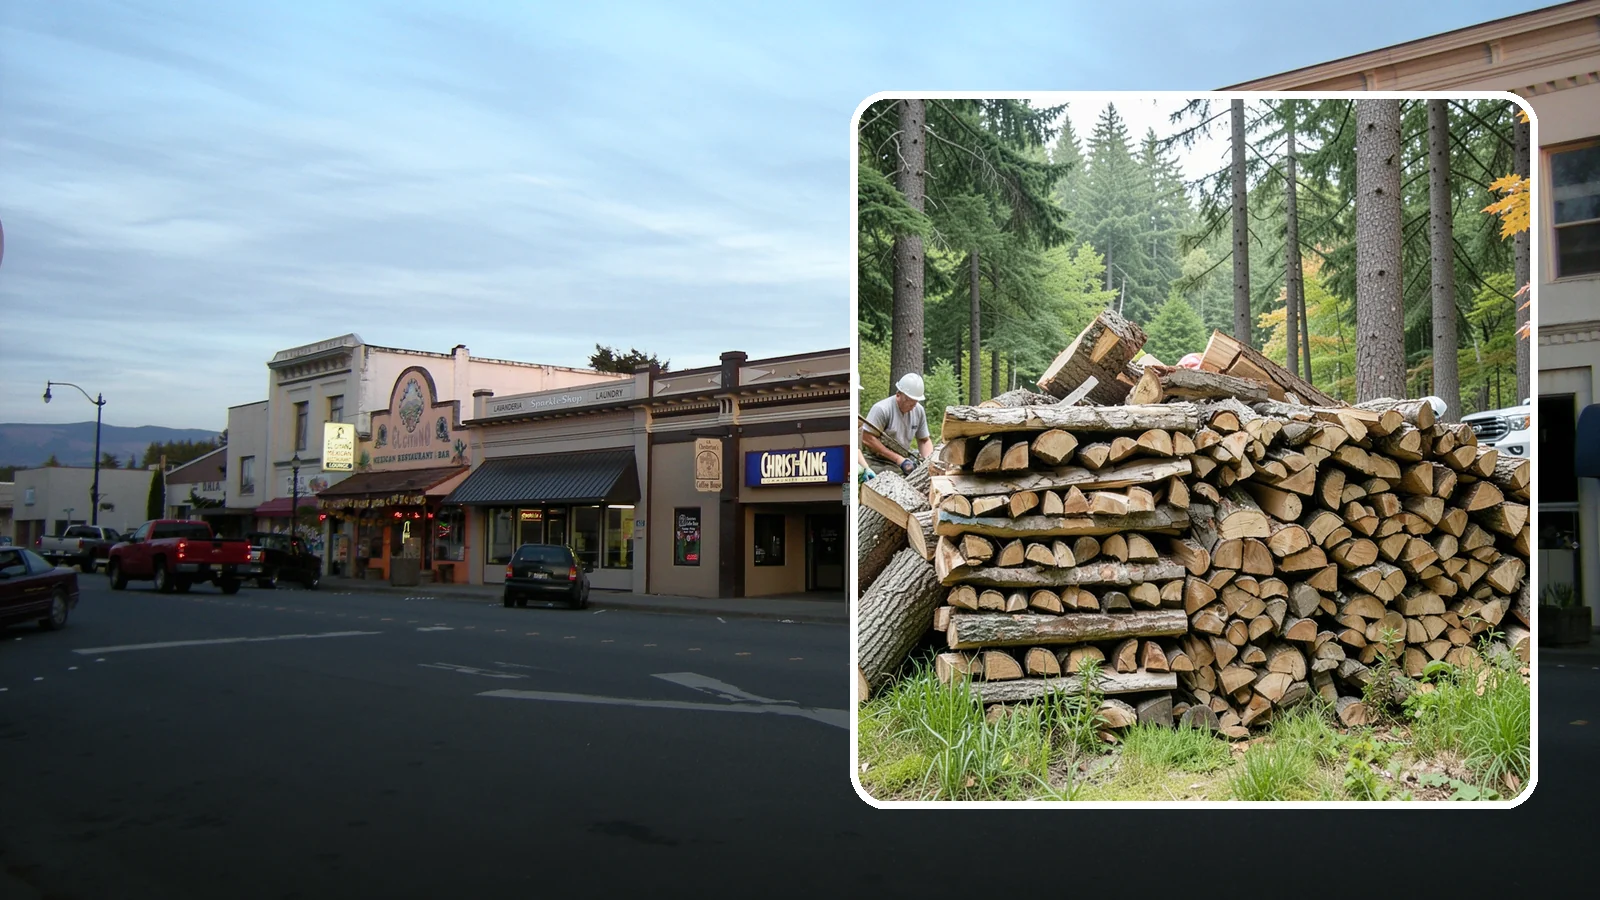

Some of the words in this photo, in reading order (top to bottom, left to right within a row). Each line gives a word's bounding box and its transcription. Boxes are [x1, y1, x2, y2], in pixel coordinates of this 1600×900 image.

[595, 389, 624, 399] LAUNDRY
[494, 402, 523, 412] LAVANDERIA
[530, 396, 561, 409] Sparkle
[562, 394, 582, 404] Shop
[373, 455, 396, 464] MEXICAN
[397, 451, 433, 462] RESTAURANT
[438, 450, 450, 458] BAR
[761, 452, 797, 477] CHRIST
[799, 450, 827, 476] KING
